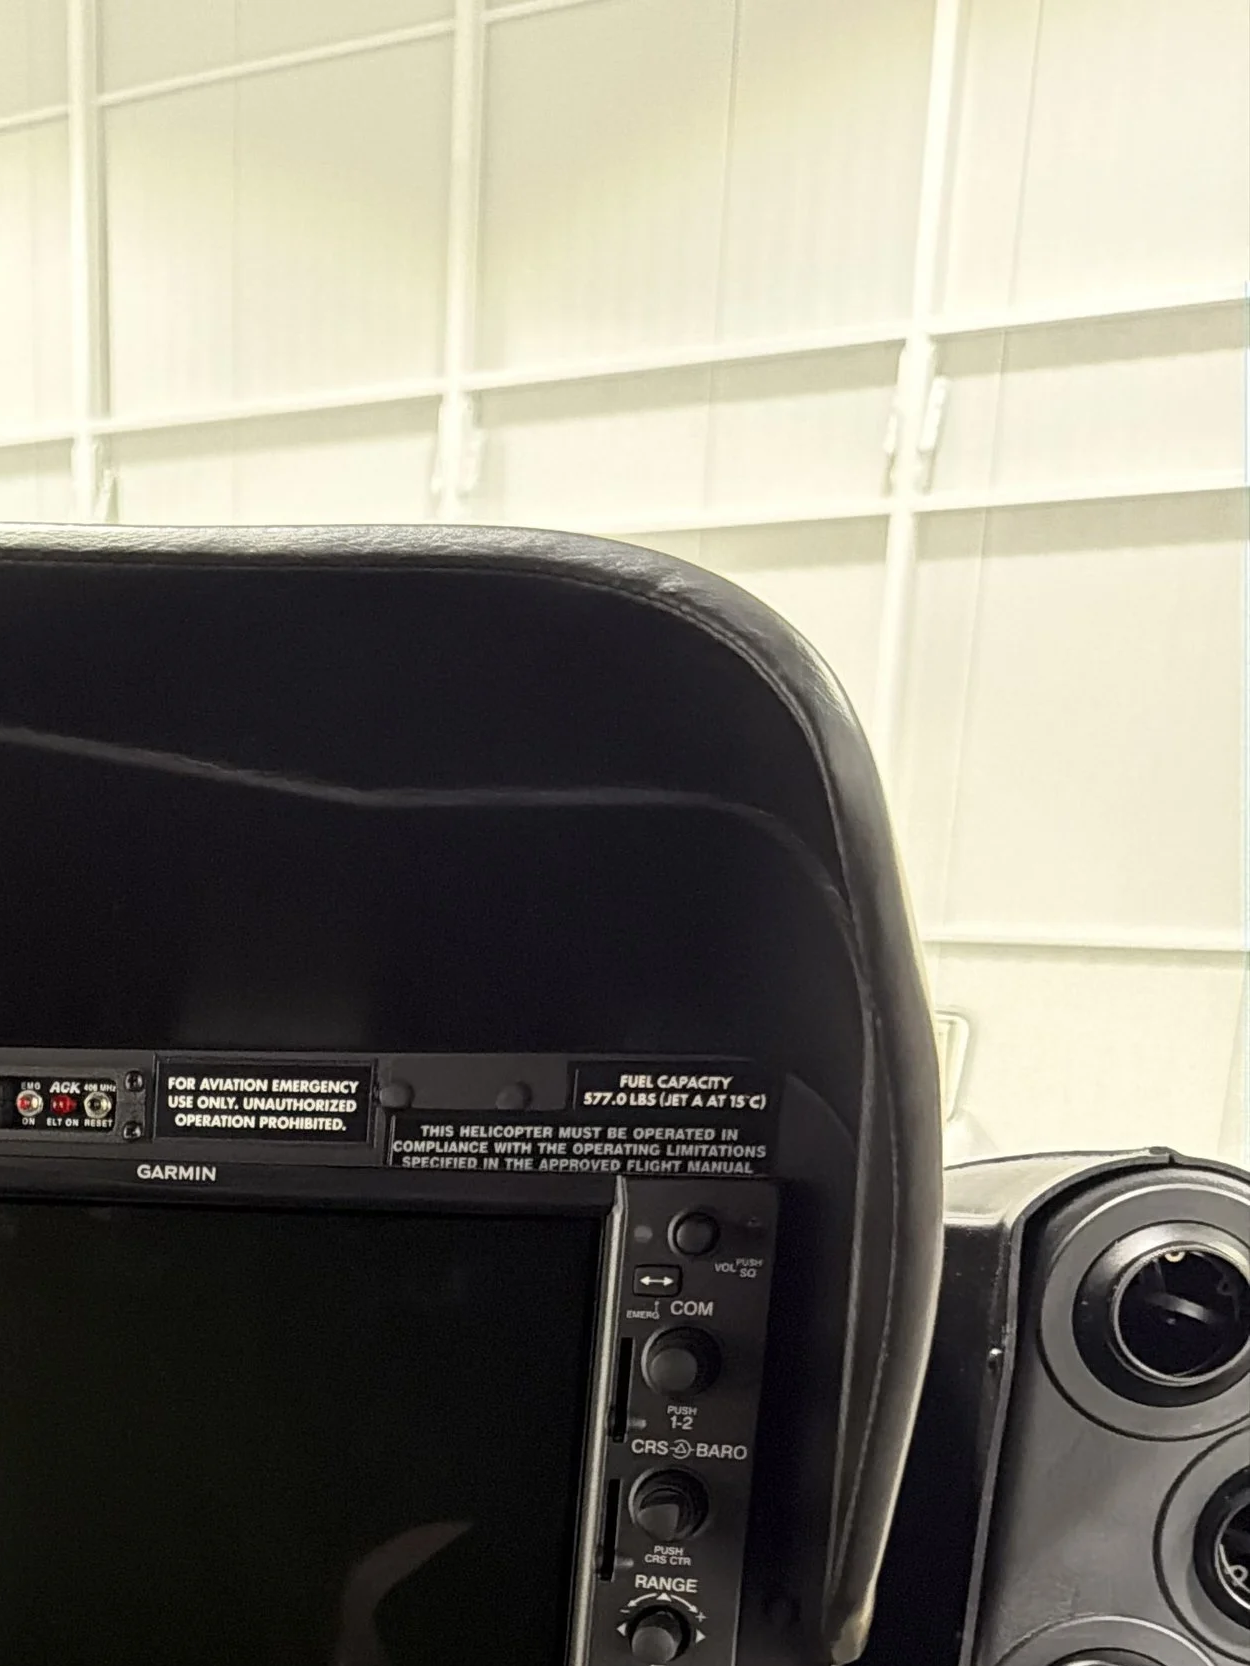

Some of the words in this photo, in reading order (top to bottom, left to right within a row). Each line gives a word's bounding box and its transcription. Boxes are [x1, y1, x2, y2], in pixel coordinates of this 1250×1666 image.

[50, 1082, 81, 1094] ACK
[168, 1077, 197, 1092] FOR
[200, 1078, 269, 1094] AVIATION
[272, 1079, 358, 1095] EMERGENCY
[620, 1075, 654, 1088] FUEL
[657, 1076, 733, 1090] CAPACITY
[169, 1096, 195, 1110] USE
[198, 1096, 238, 1111] ONLY.
[243, 1098, 356, 1112] UNAUTHORIZED
[584, 1093, 627, 1106] 577.0
[630, 1093, 656, 1107] LBS
[659, 1094, 687, 1108] (JET
[690, 1094, 703, 1107] A
[706, 1095, 726, 1107] AT
[22, 1118, 35, 1126] ON
[47, 1118, 62, 1126] ELT
[65, 1118, 79, 1126] ON
[84, 1119, 113, 1128] RESET
[175, 1114, 255, 1129] OPERATION
[259, 1115, 346, 1131] PROHIBITED.
[421, 1125, 454, 1137] THIS
[460, 1126, 552, 1138] HELICOPTER
[559, 1127, 600, 1139] MUST
[608, 1128, 627, 1139] BE
[633, 1128, 714, 1141] OPERATED
[721, 1129, 738, 1140] IN
[393, 1141, 488, 1154] COMPLIANCE
[494, 1143, 532, 1154] WITH
[537, 1143, 566, 1155] THE
[572, 1144, 660, 1157] OPERATING
[666, 1145, 766, 1158] LIMITATIONS
[402, 1156, 477, 1169] SPECIFIED
[483, 1158, 499, 1169] IN
[504, 1158, 533, 1170] THE
[538, 1159, 621, 1172] APPROVED
[627, 1160, 681, 1172] FLIGHT
[687, 1161, 753, 1174] MANUAL
[137, 1165, 216, 1182] GARMIN
[715, 1263, 735, 1272] VOL
[736, 1258, 763, 1267] PUSH
[740, 1268, 756, 1278] SQ
[670, 1301, 713, 1316] COM
[668, 1406, 697, 1415] PUSH
[670, 1417, 693, 1430] 1-2
[632, 1439, 668, 1455] CRS
[696, 1443, 747, 1460] BARO
[654, 1546, 683, 1555] PUSH
[645, 1555, 666, 1564] CRS
[670, 1556, 691, 1566] CTR
[635, 1574, 698, 1593] RANGE
